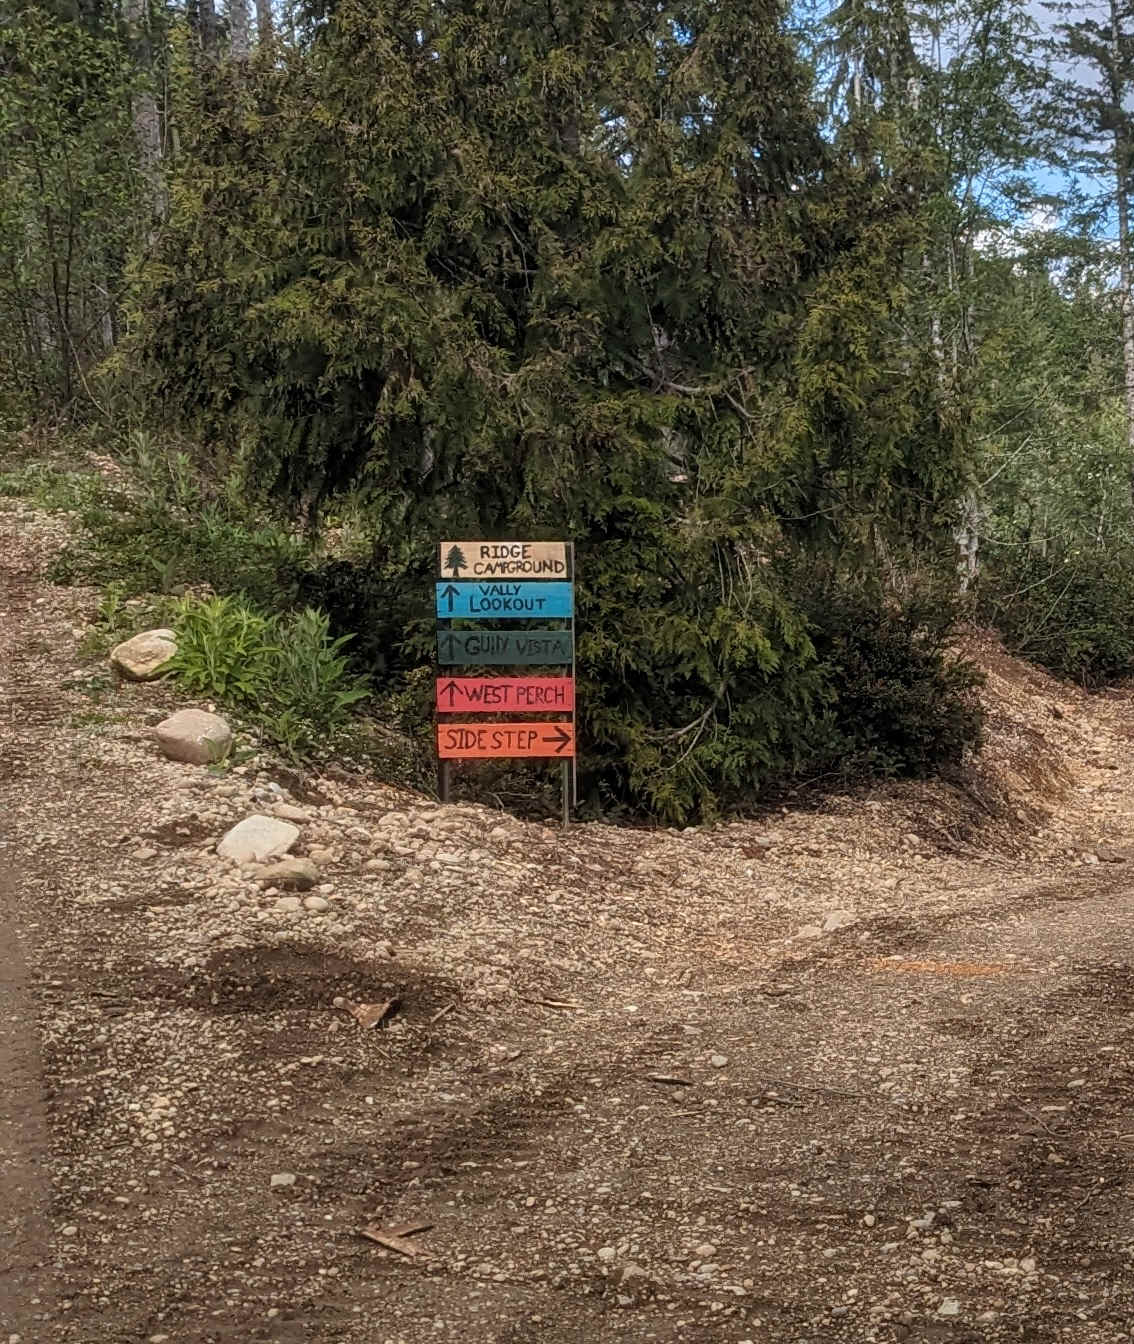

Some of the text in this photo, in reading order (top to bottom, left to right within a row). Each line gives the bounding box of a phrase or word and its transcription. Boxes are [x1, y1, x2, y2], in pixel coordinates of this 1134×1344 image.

[480, 544, 532, 559] RIDGE
[473, 559, 565, 575] CAMPGROUND
[479, 584, 522, 596] VALLY
[469, 596, 547, 613] LOOKOUT
[516, 639, 566, 656] VISTA
[464, 684, 565, 705] WEST PERCH
[444, 728, 538, 750] SIDE STEP
